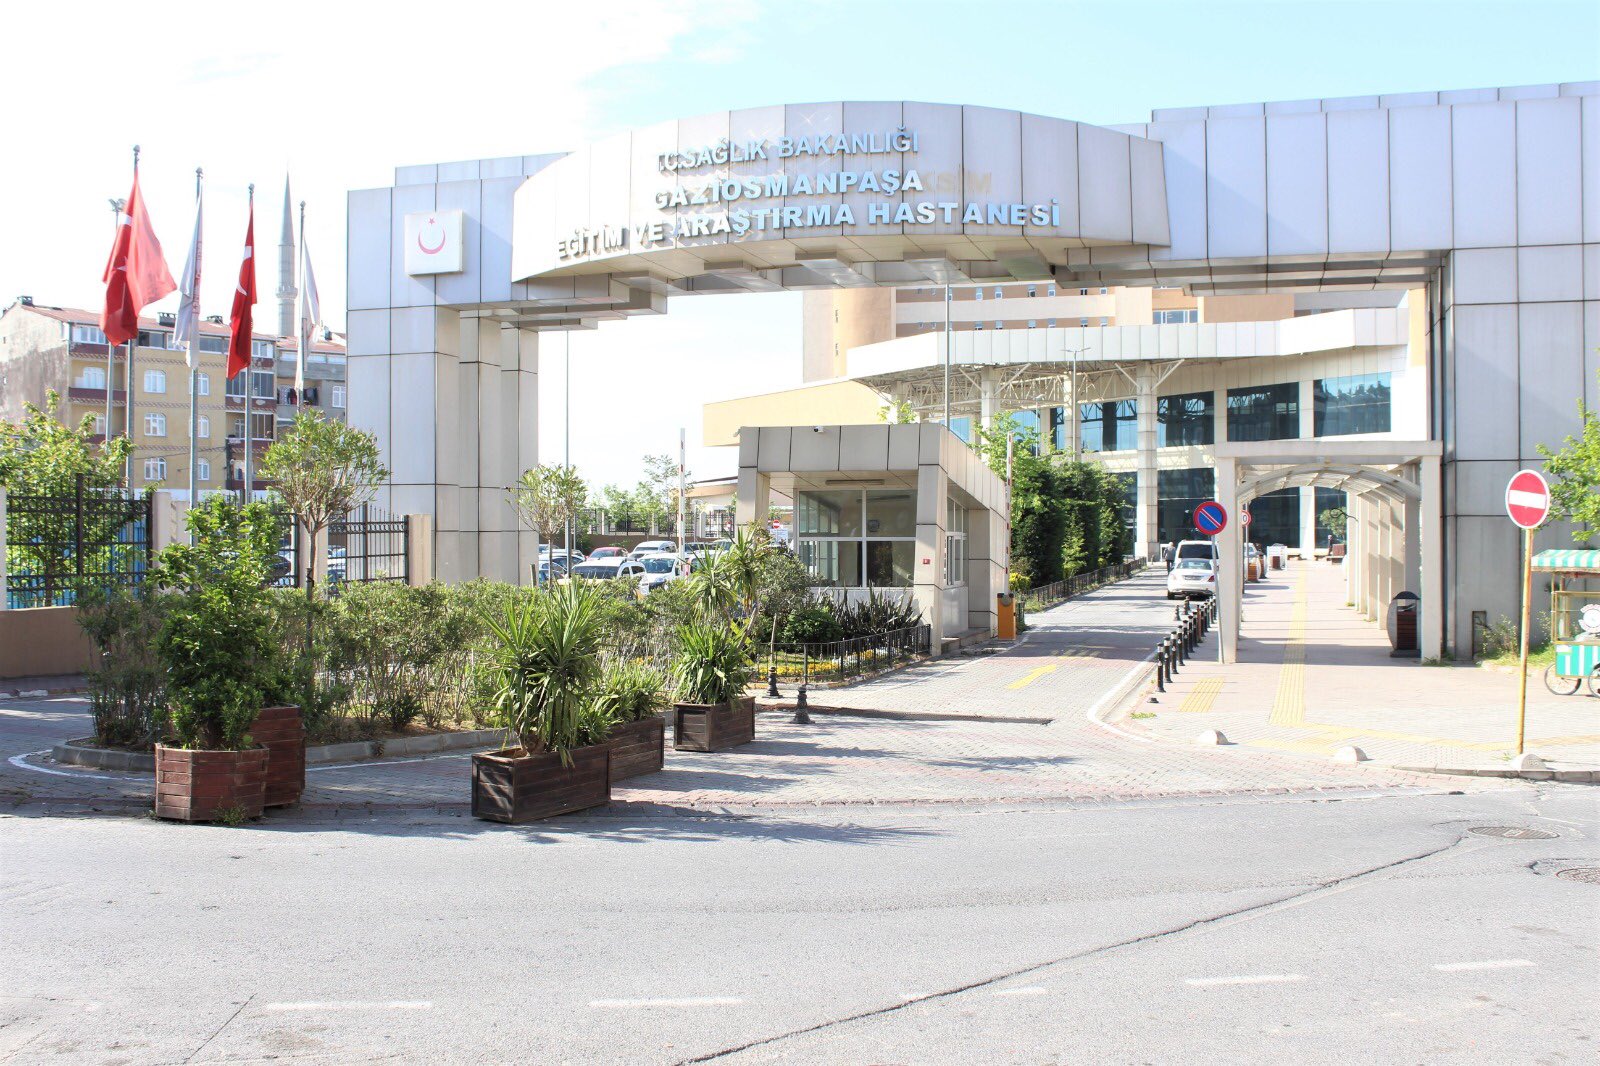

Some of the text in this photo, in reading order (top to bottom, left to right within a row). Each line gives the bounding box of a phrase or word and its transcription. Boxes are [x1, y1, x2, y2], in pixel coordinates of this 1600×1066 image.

[777, 124, 919, 158] BAKANLIĞI
[631, 219, 665, 245] VE
[672, 202, 857, 237] ARAŞTIRMA
[868, 198, 1061, 227] HASTANESİ
